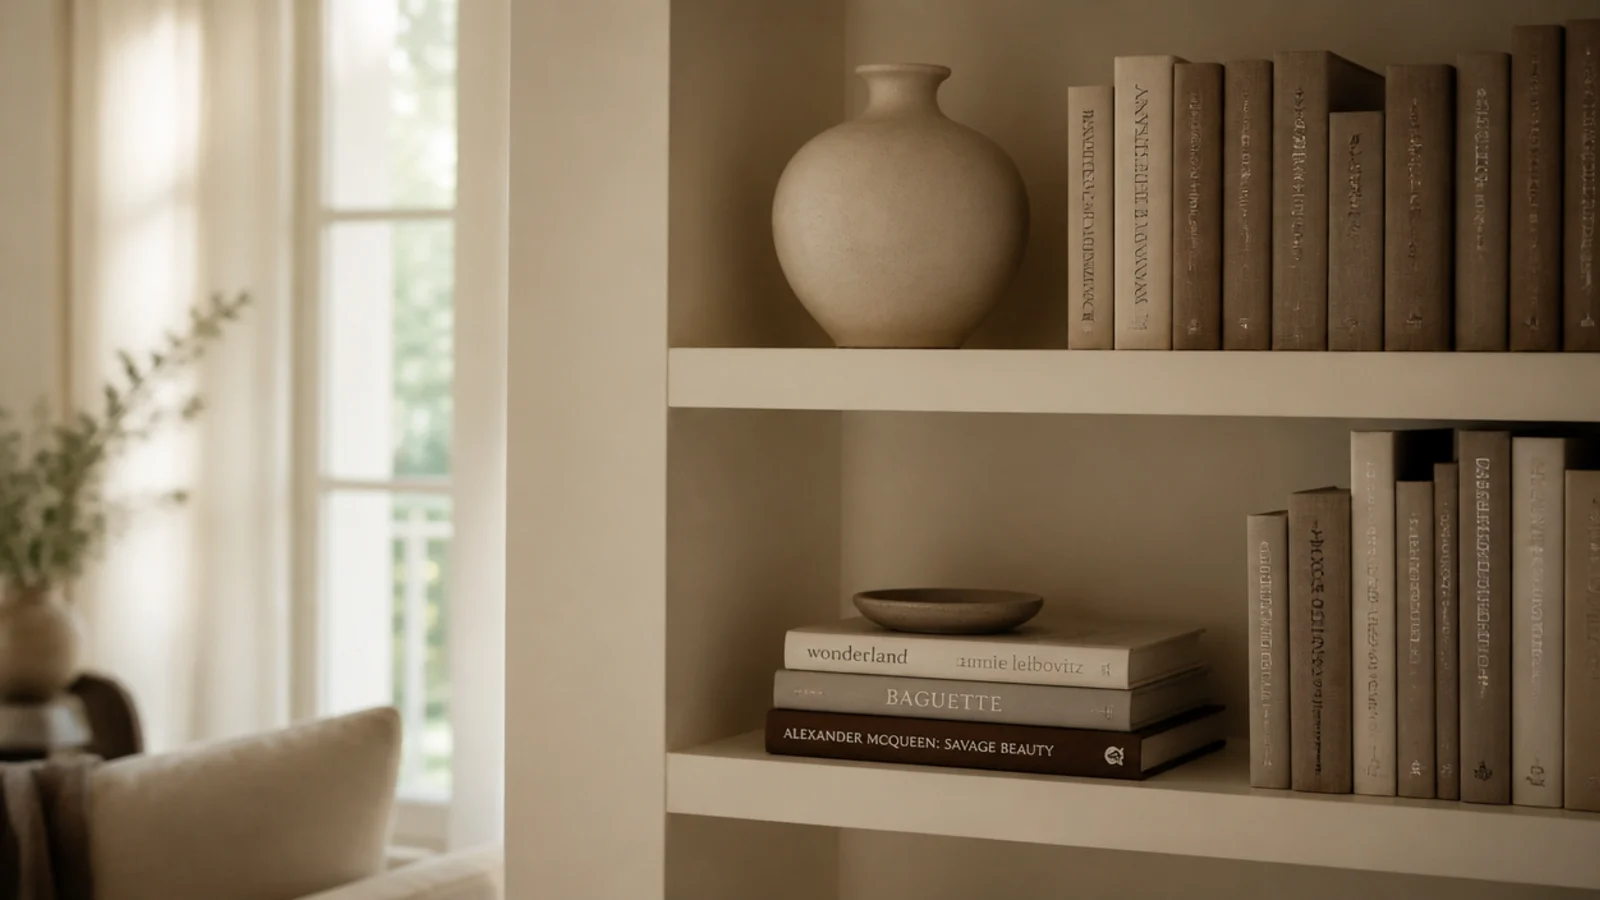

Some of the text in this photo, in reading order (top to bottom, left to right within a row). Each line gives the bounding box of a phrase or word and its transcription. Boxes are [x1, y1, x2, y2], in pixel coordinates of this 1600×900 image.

[807, 645, 908, 665] wonderland
[886, 688, 1003, 713] BAGUETTE
[783, 728, 1055, 757] ALEXANDER MCQUEEN: SAVAGE BEAUTY
